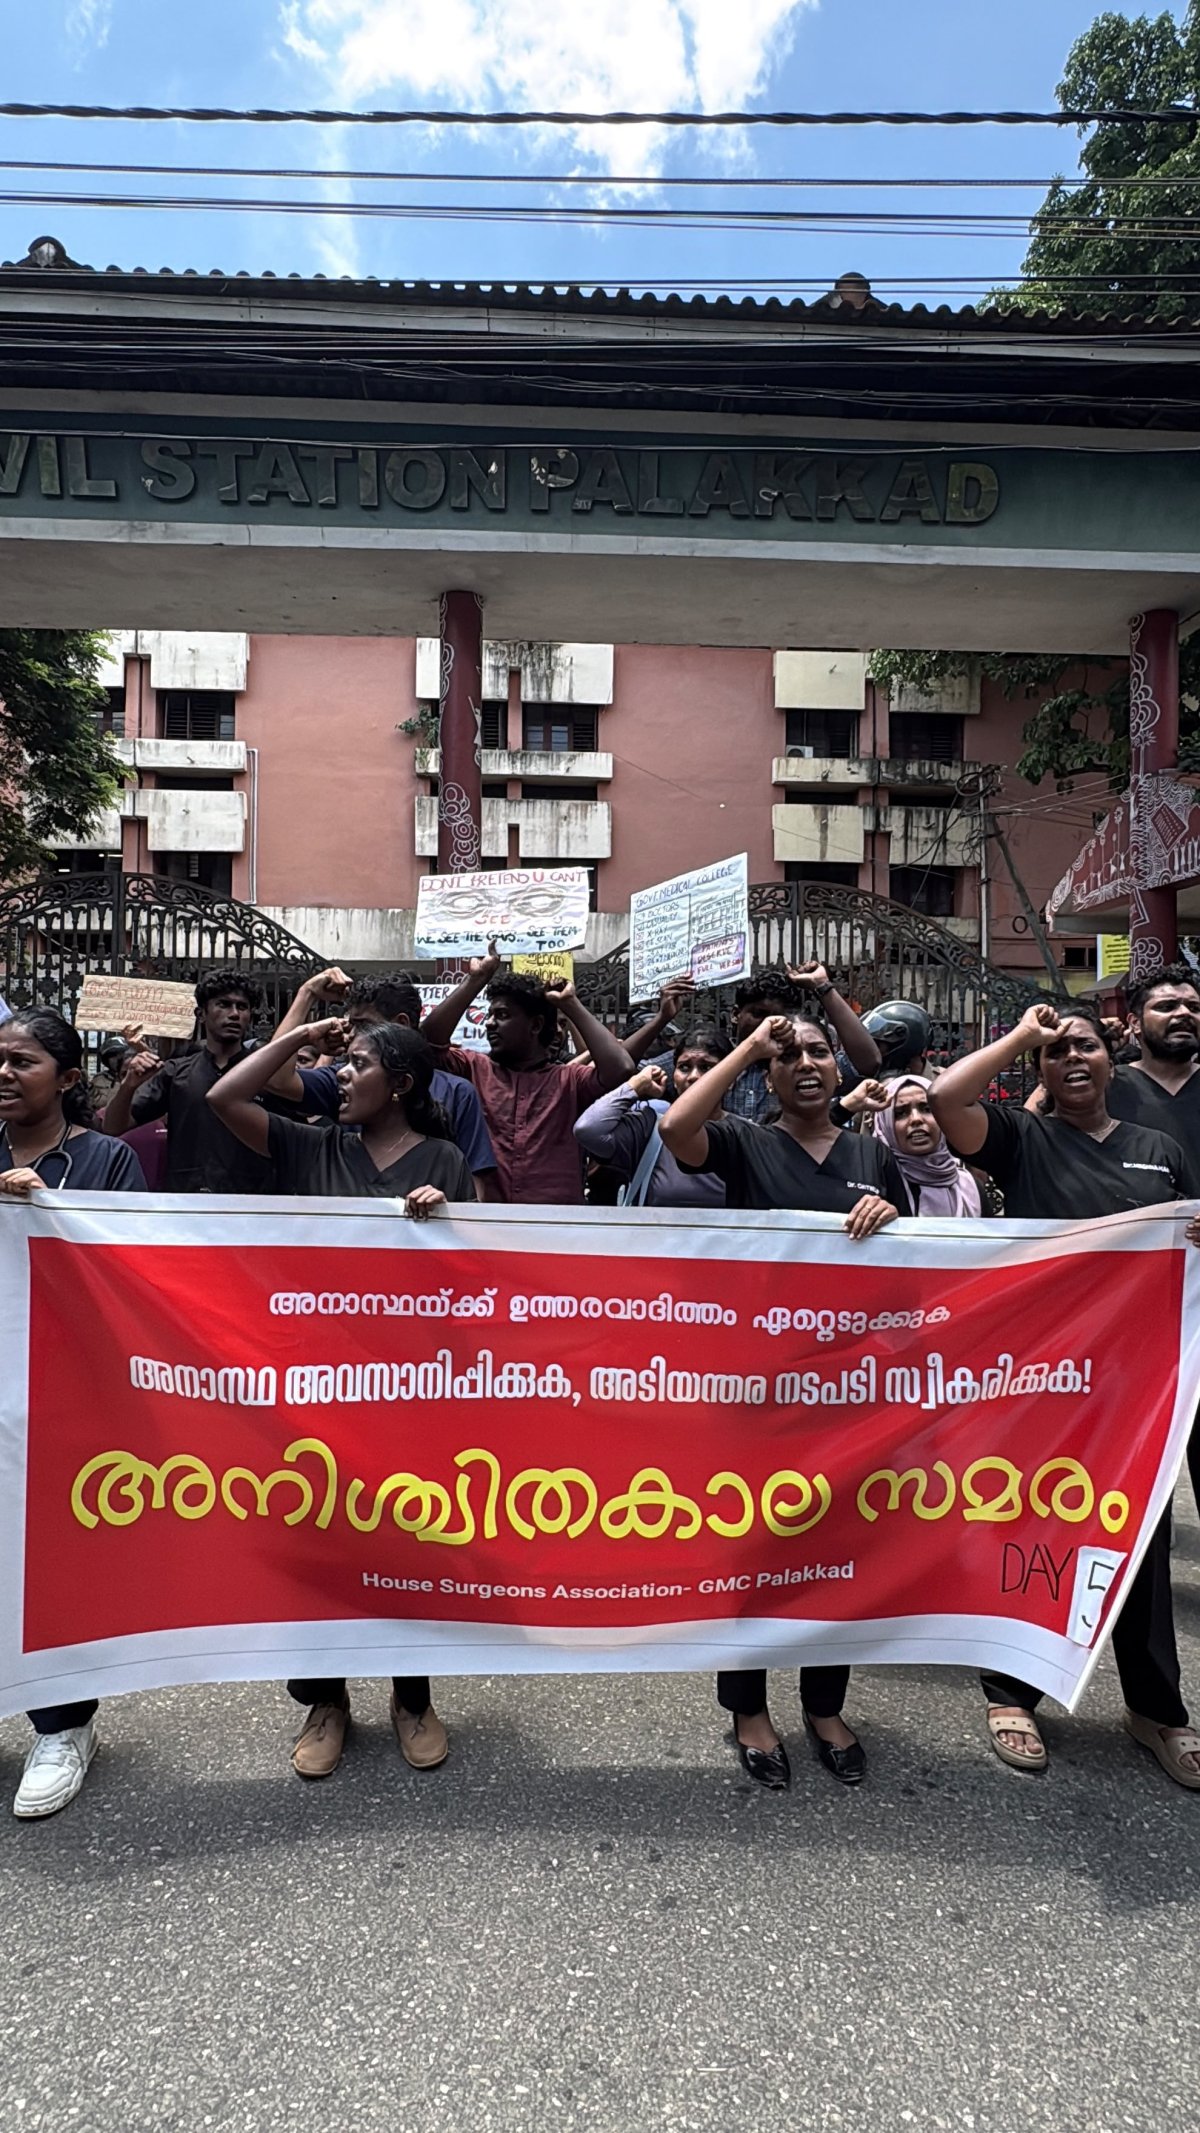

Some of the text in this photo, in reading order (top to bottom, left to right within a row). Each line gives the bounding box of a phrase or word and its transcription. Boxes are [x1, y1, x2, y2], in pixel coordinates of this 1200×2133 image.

[140, 438, 508, 511] STATION
[530, 448, 1000, 524] PALAKKAD
[533, 871, 544, 883] U
[696, 864, 733, 885] COLLEGE
[417, 932, 435, 944] WE
[438, 931, 460, 943] SEE
[464, 931, 483, 942] THE
[527, 925, 547, 937] SEE
[475, 914, 511, 925] SEE
[697, 963, 713, 975] FULL
[269, 1287, 951, 1342] അനാസ്ഥയ്ക്ക് ഉത്തരവാദിത്തം ഏറ്റെടുക്കുക
[129, 1348, 1092, 1410] അനാസ്ഥ അവസാനിപ്പിക്കുക, അടിയന്തര നടപടി സ്വീകരിക്കുക!
[71, 1437, 1129, 1545] അനിശ്ചിതകാല സമരം
[362, 1560, 854, 1599] House Surgeons Association- GMC Palakkad
[1002, 1542, 1115, 1629] DAY 5
